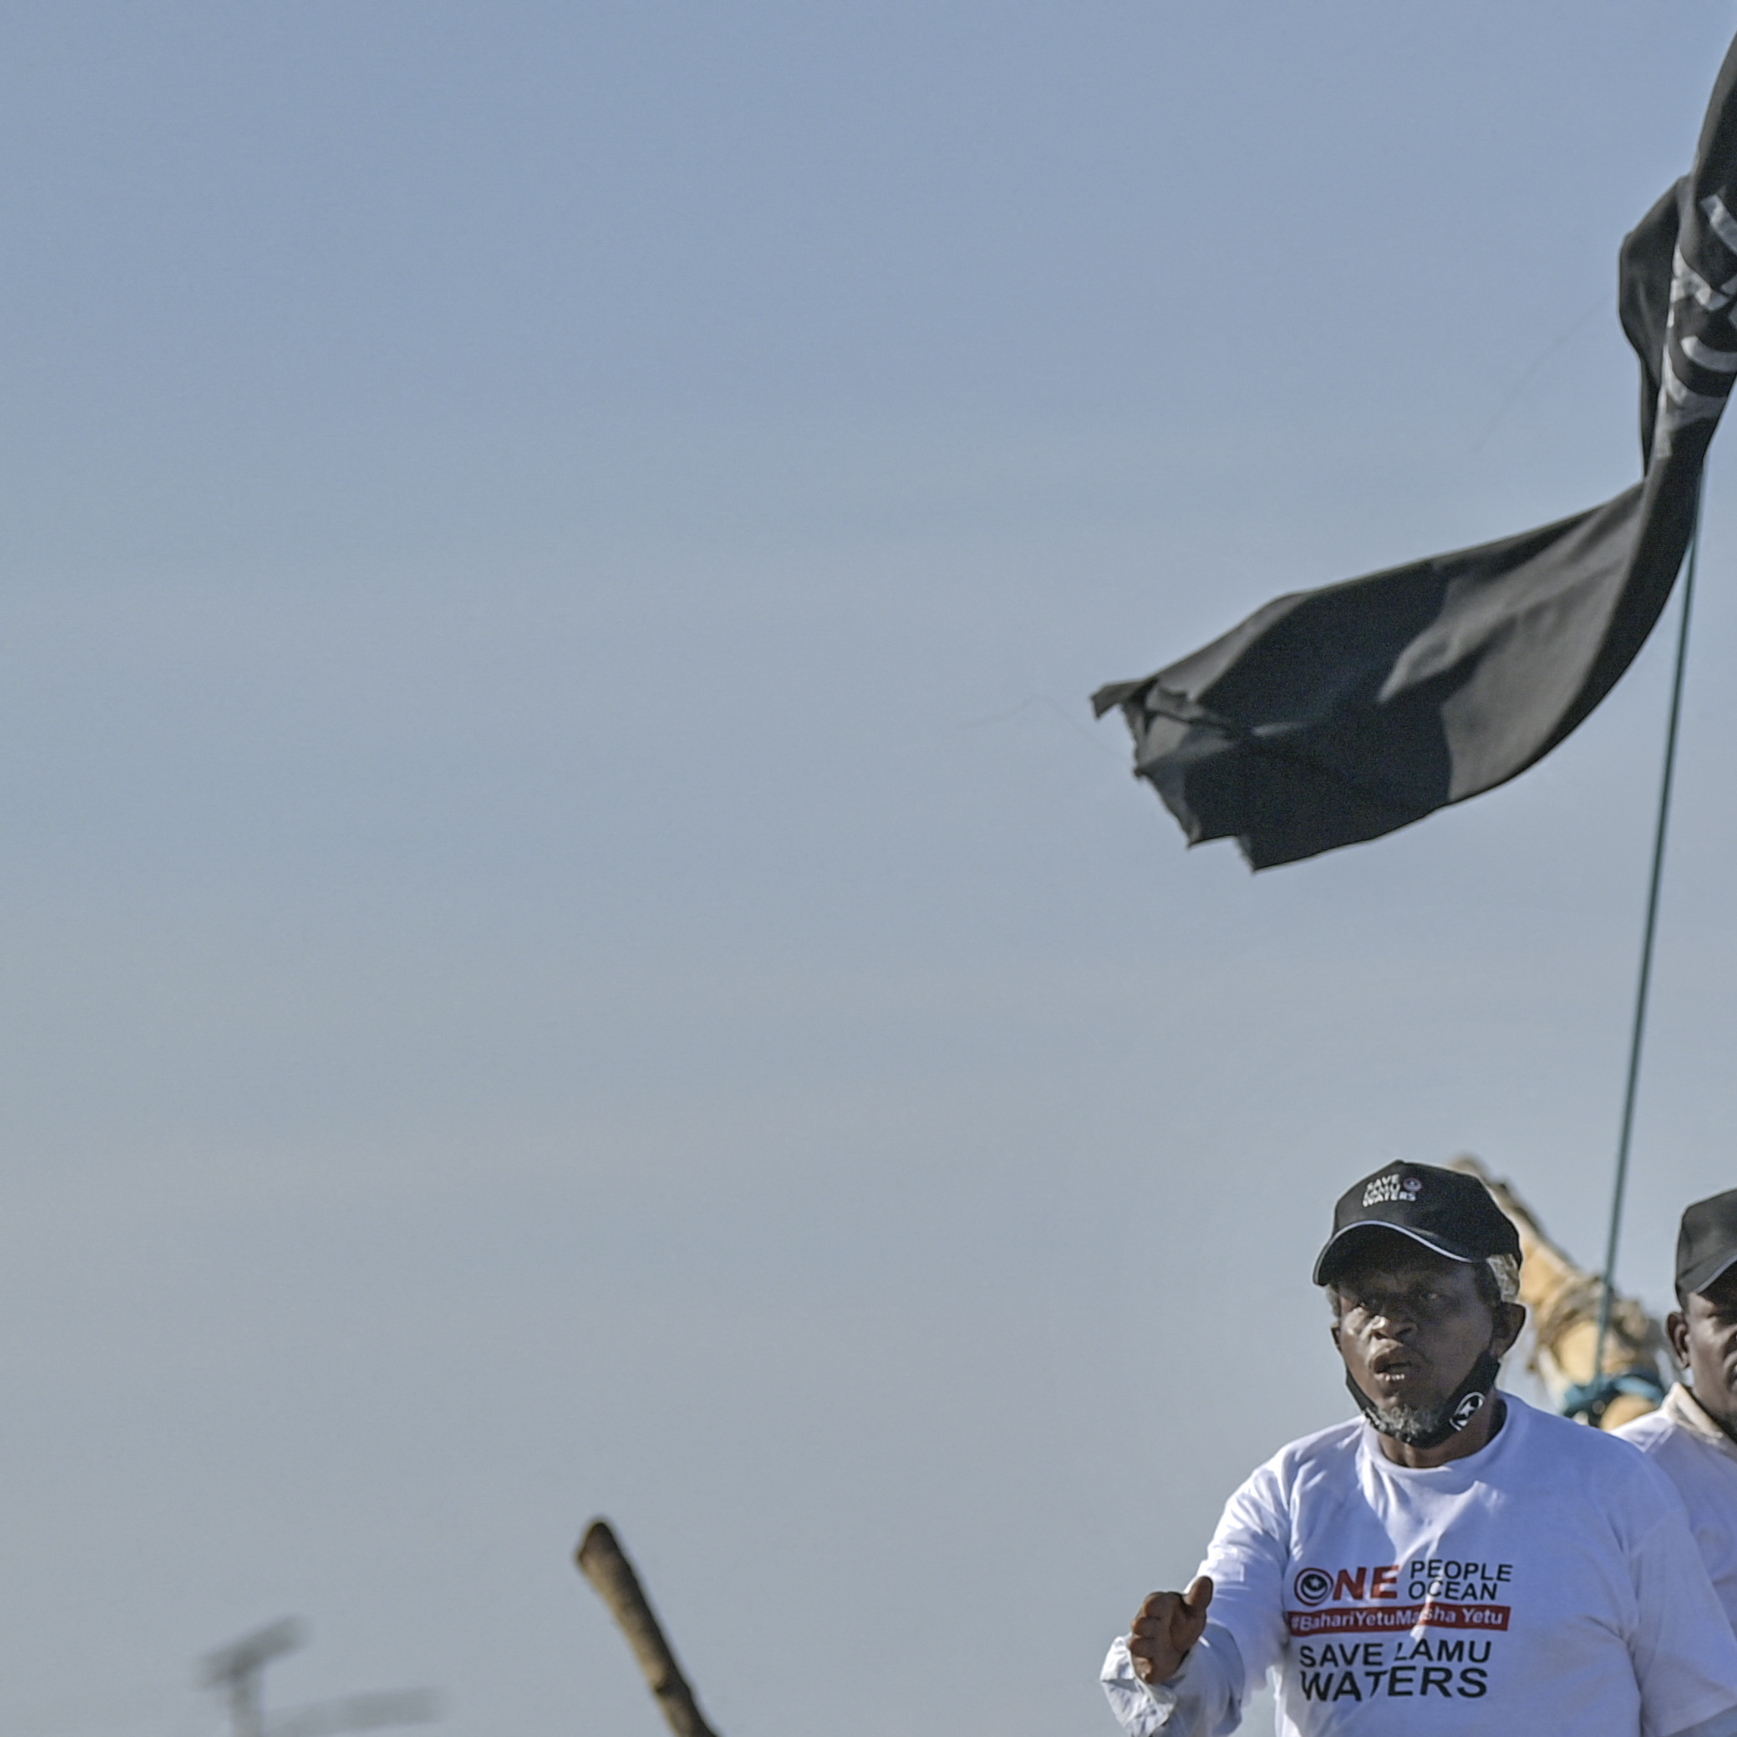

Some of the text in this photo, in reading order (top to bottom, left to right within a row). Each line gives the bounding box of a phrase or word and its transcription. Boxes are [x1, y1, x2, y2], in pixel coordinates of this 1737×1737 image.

[1409, 1558, 1514, 1583] PEOPLE
[1294, 1564, 1400, 1607] ONE
[1408, 1580, 1498, 1602] OCEAN
[1291, 1605, 1504, 1632] #BahariYetuMasha Yetu
[1299, 1638, 1492, 1668] SAVE LAMU
[1299, 1665, 1489, 1703] WATERS
